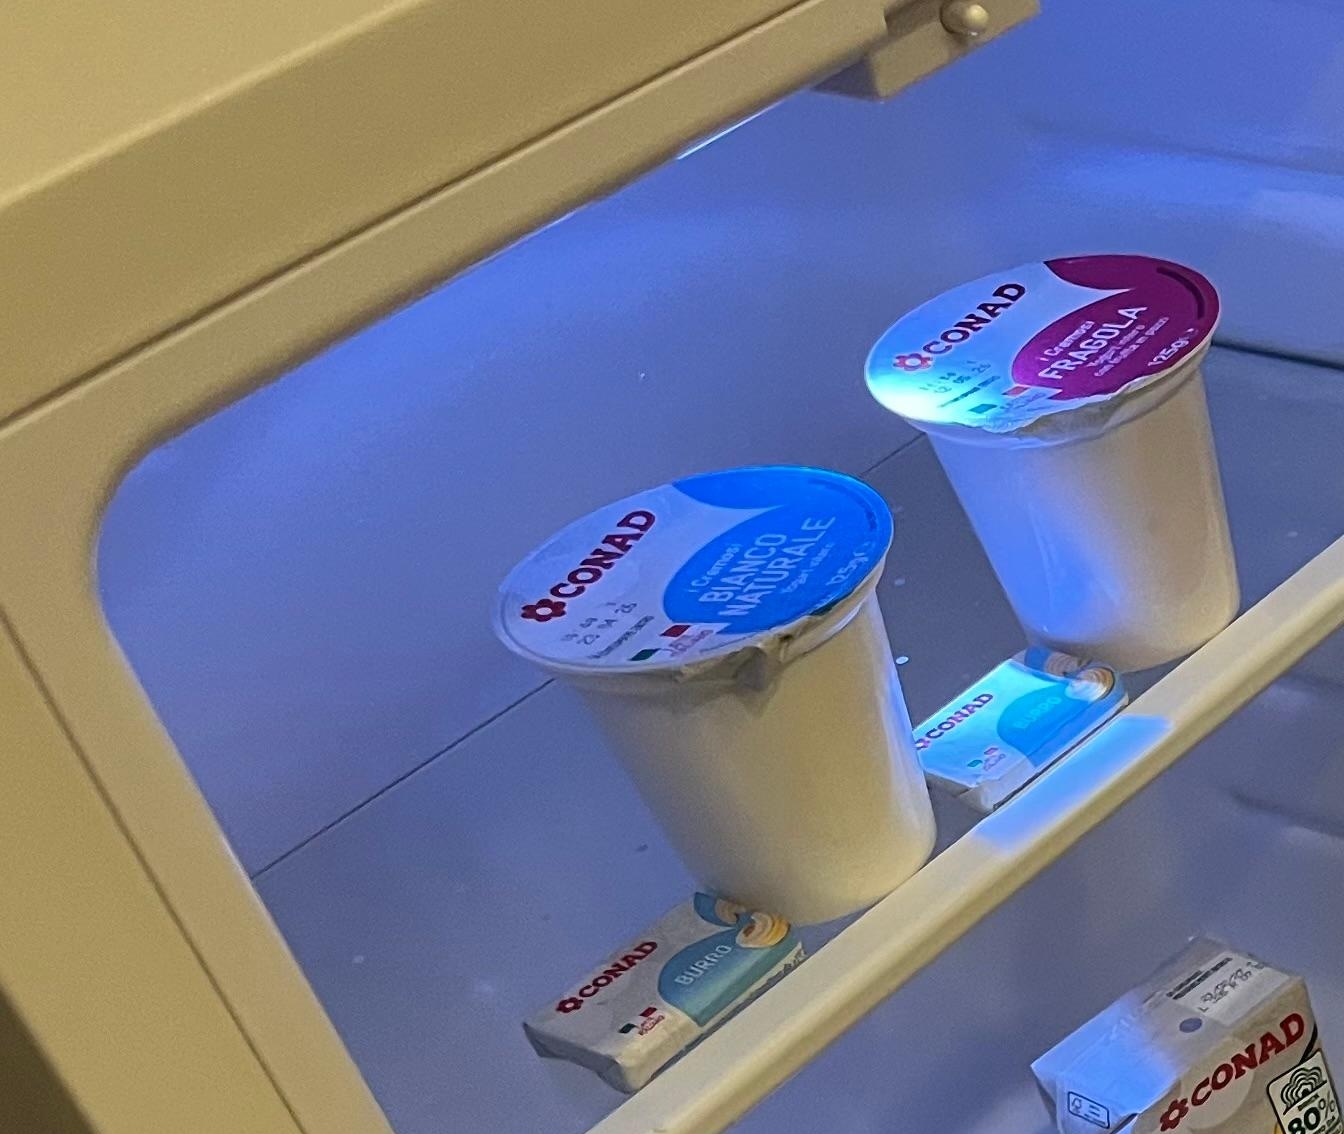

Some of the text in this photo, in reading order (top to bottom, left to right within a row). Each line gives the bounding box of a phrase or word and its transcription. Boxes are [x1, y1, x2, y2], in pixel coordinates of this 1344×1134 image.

[922, 283, 1027, 355] CONAD
[1038, 306, 1148, 379] FRAGOLA
[549, 509, 657, 599] CONAD
[698, 532, 788, 604] BIANCO
[717, 516, 837, 618] NATURALE
[925, 692, 995, 740] CONAD
[578, 940, 659, 998] CONAD
[674, 943, 734, 988] BURRO
[1188, 1012, 1306, 1109] CONAD
